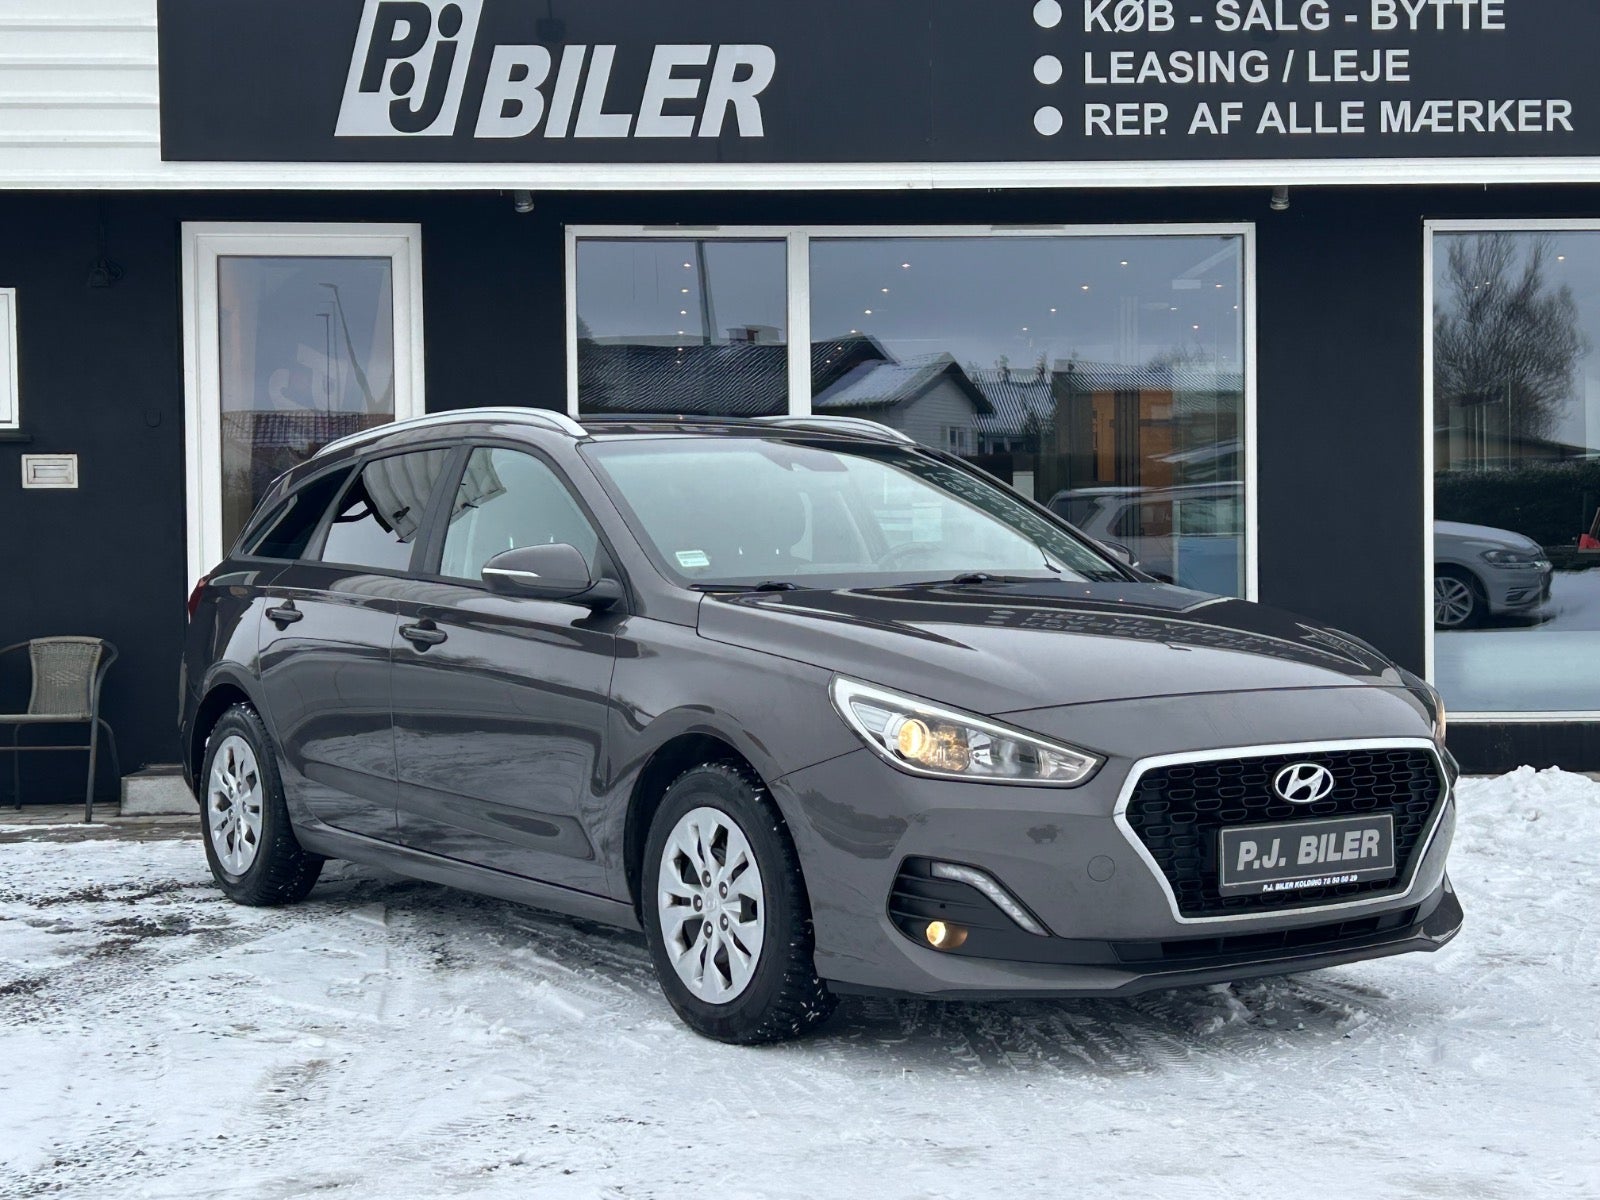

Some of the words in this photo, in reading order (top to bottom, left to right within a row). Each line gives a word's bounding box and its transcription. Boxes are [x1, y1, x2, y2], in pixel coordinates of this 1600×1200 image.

[1084, 0, 1175, 33] KØB
[1214, 0, 1330, 32] SALG
[1371, 0, 1506, 31] BYTTE
[1084, 50, 1269, 84] LEASING
[1308, 49, 1411, 82] LEJE
[474, 44, 776, 139] BILER
[1084, 102, 1169, 136] REP.
[1187, 101, 1243, 135] AF
[1255, 101, 1365, 135] ALLE
[1380, 99, 1574, 133] MÆRKER
[1236, 838, 1287, 871] P.J.
[1297, 829, 1381, 865] BILER
[1275, 881, 1294, 891] BILER
